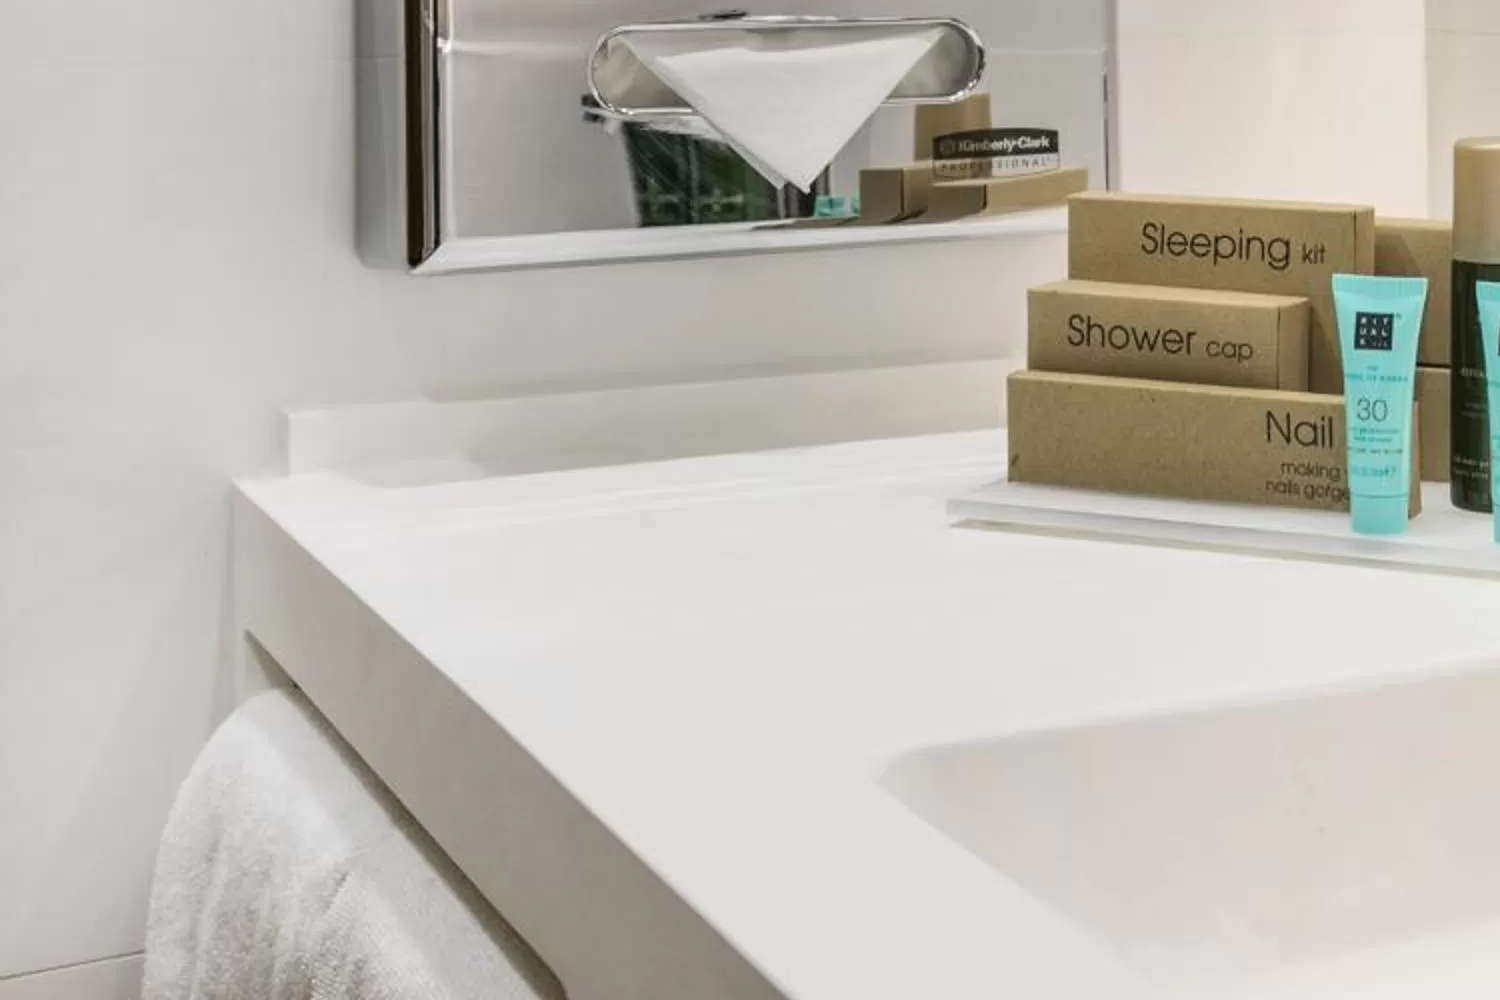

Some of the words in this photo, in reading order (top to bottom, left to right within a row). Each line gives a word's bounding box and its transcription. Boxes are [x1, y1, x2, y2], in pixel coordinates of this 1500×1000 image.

[1141, 222, 1291, 271] Sleeping
[1301, 244, 1327, 265] kit
[1067, 314, 1197, 356] Shower
[1206, 341, 1254, 363] cap
[1356, 396, 1389, 423] 30
[1265, 410, 1334, 449] Nail
[1280, 462, 1341, 482] making
